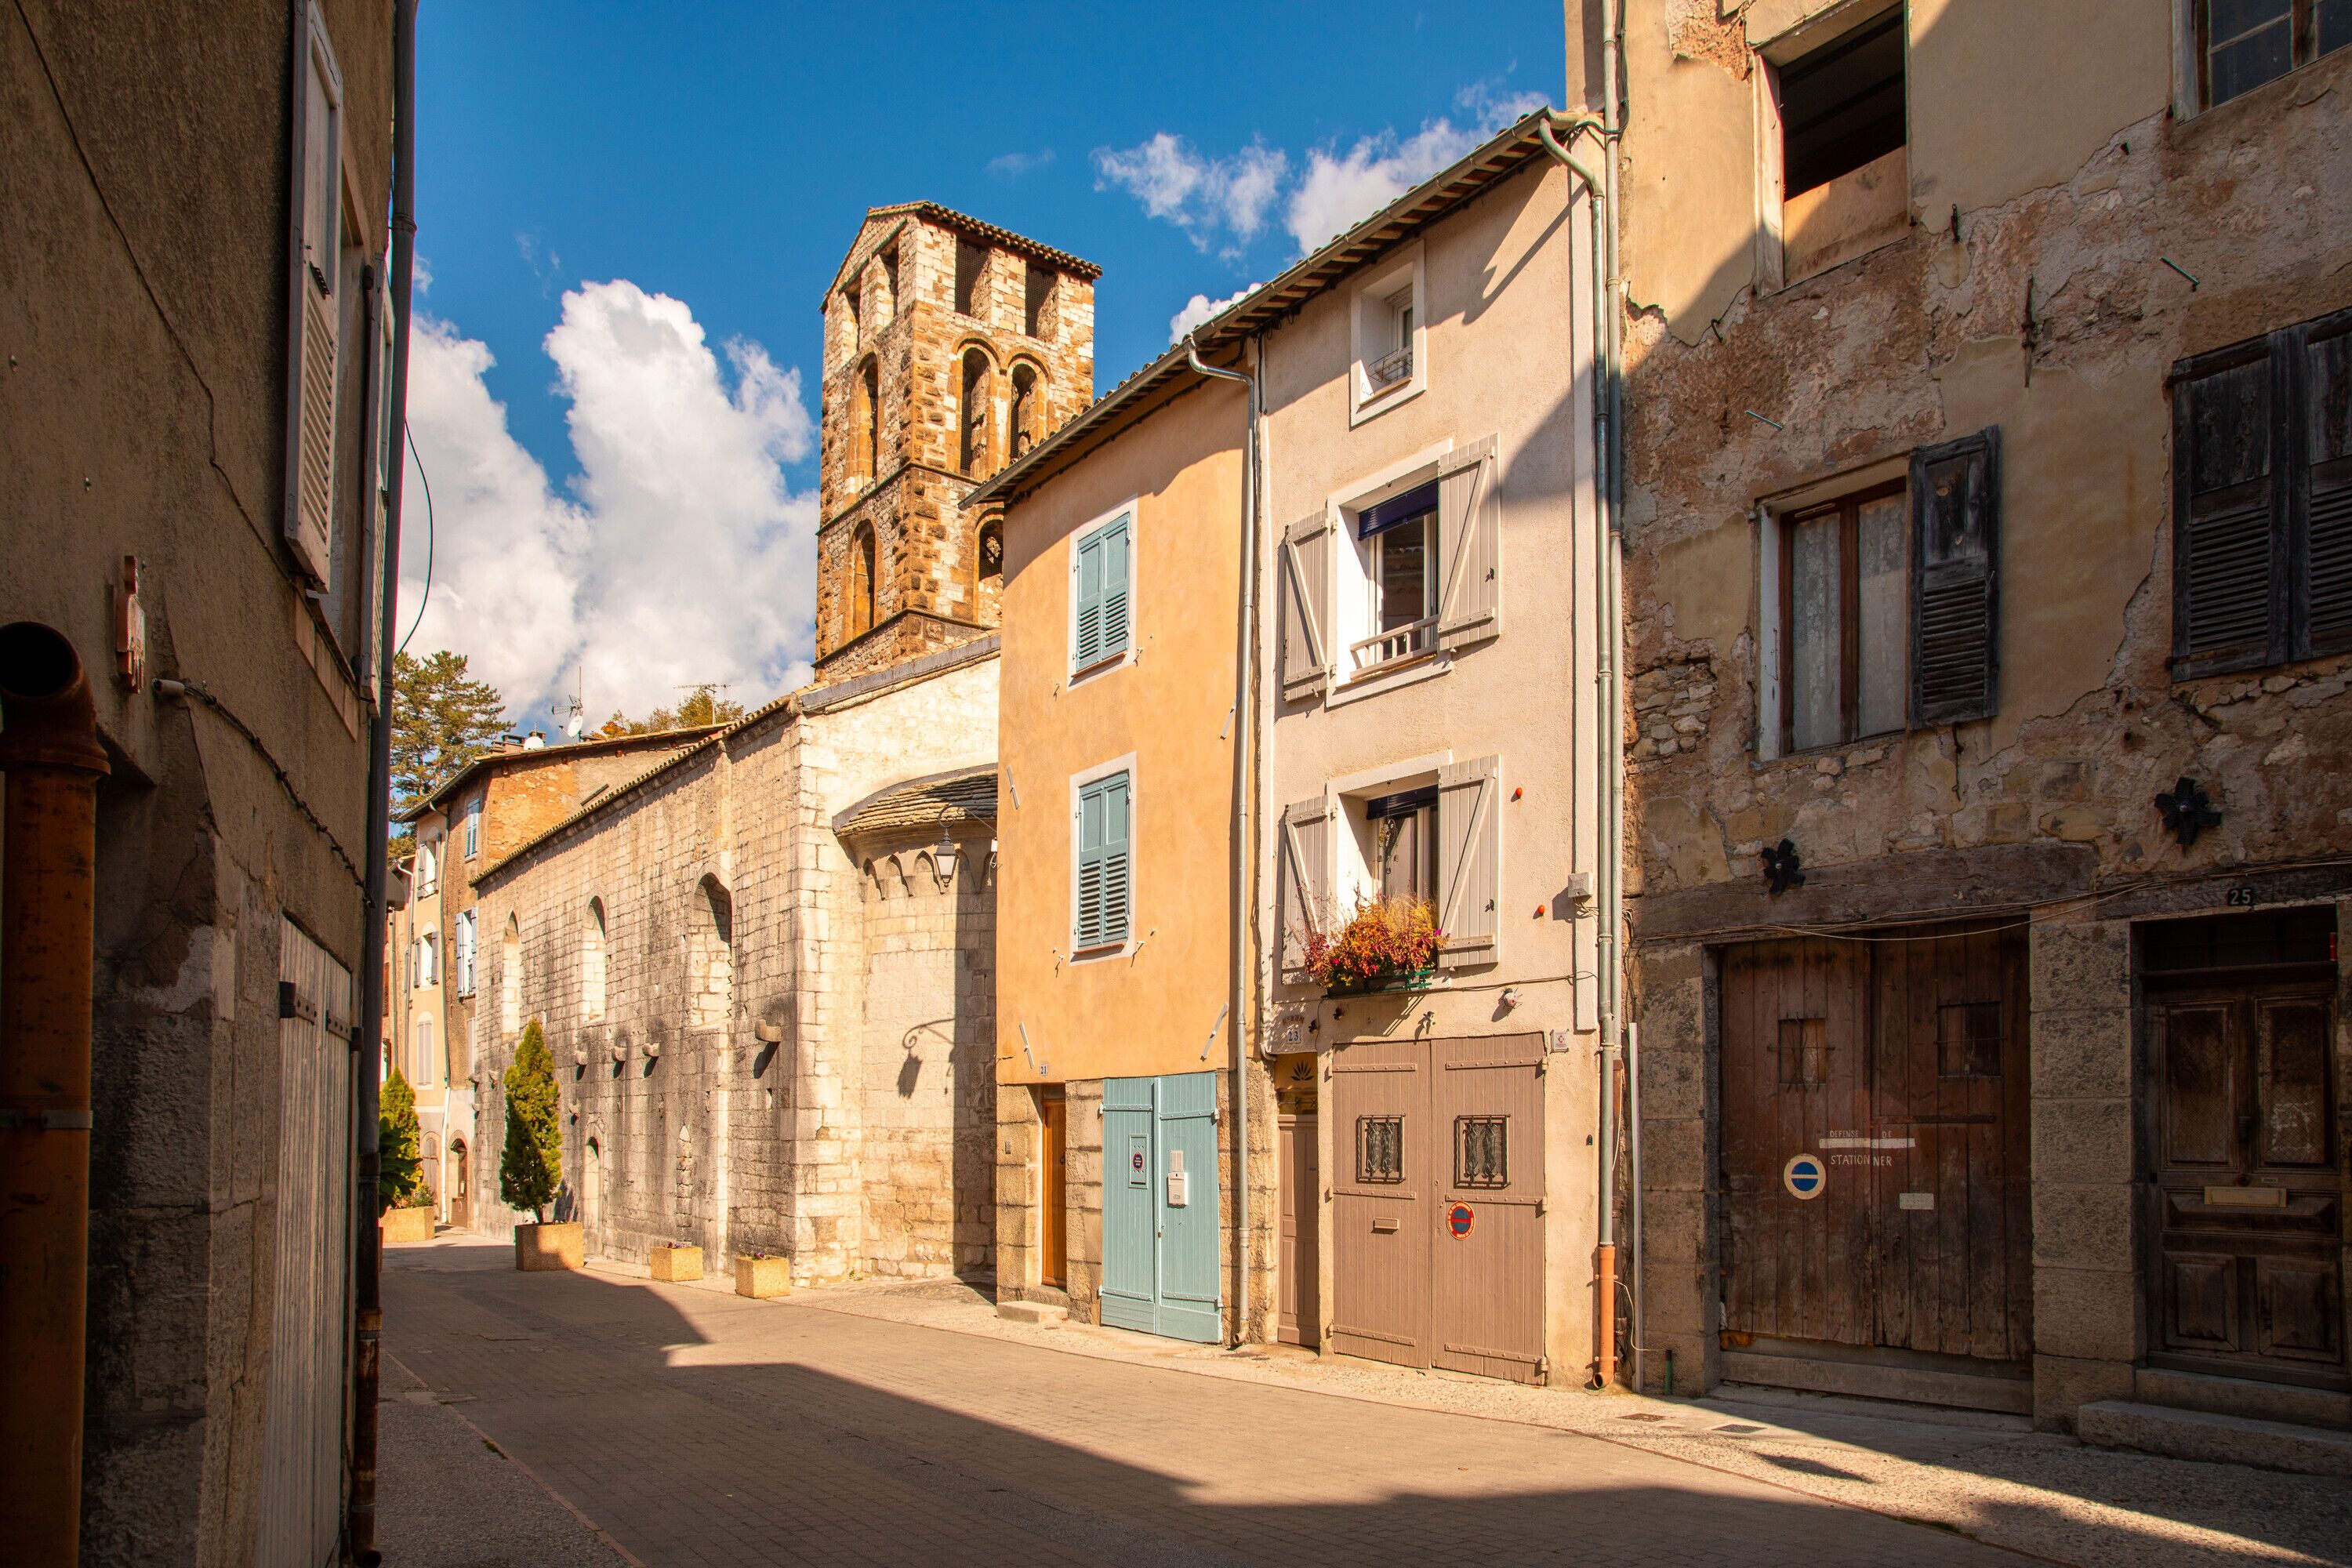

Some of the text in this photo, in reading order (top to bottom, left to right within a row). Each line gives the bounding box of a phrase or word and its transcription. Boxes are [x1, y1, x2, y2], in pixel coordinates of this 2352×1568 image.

[2230, 889, 2252, 906] 25
[1288, 1031, 1299, 1041] 23
[1829, 1130, 1860, 1138] DEFENSE
